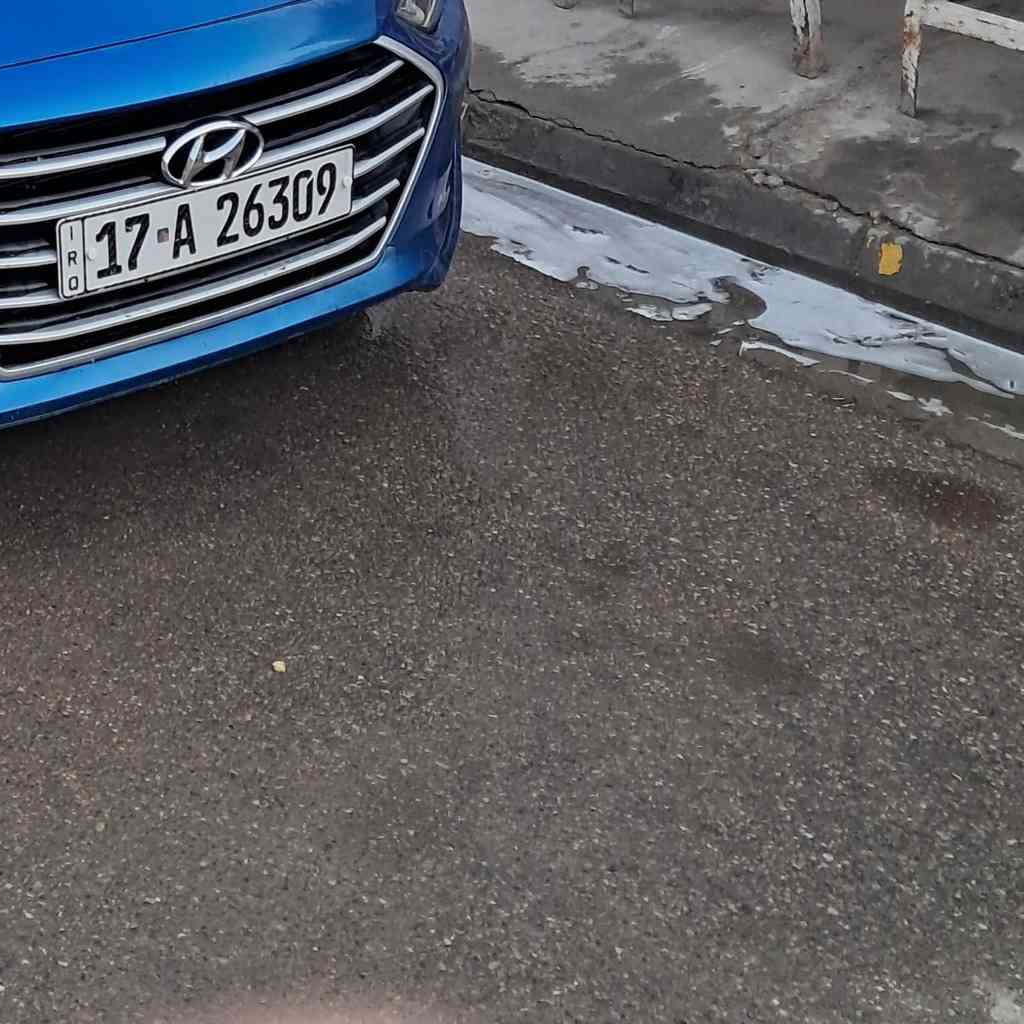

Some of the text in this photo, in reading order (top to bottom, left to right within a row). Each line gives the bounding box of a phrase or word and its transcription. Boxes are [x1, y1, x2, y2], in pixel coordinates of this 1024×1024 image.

[66, 225, 80, 292] IRQ
[95, 161, 338, 280] 17 A 26309
